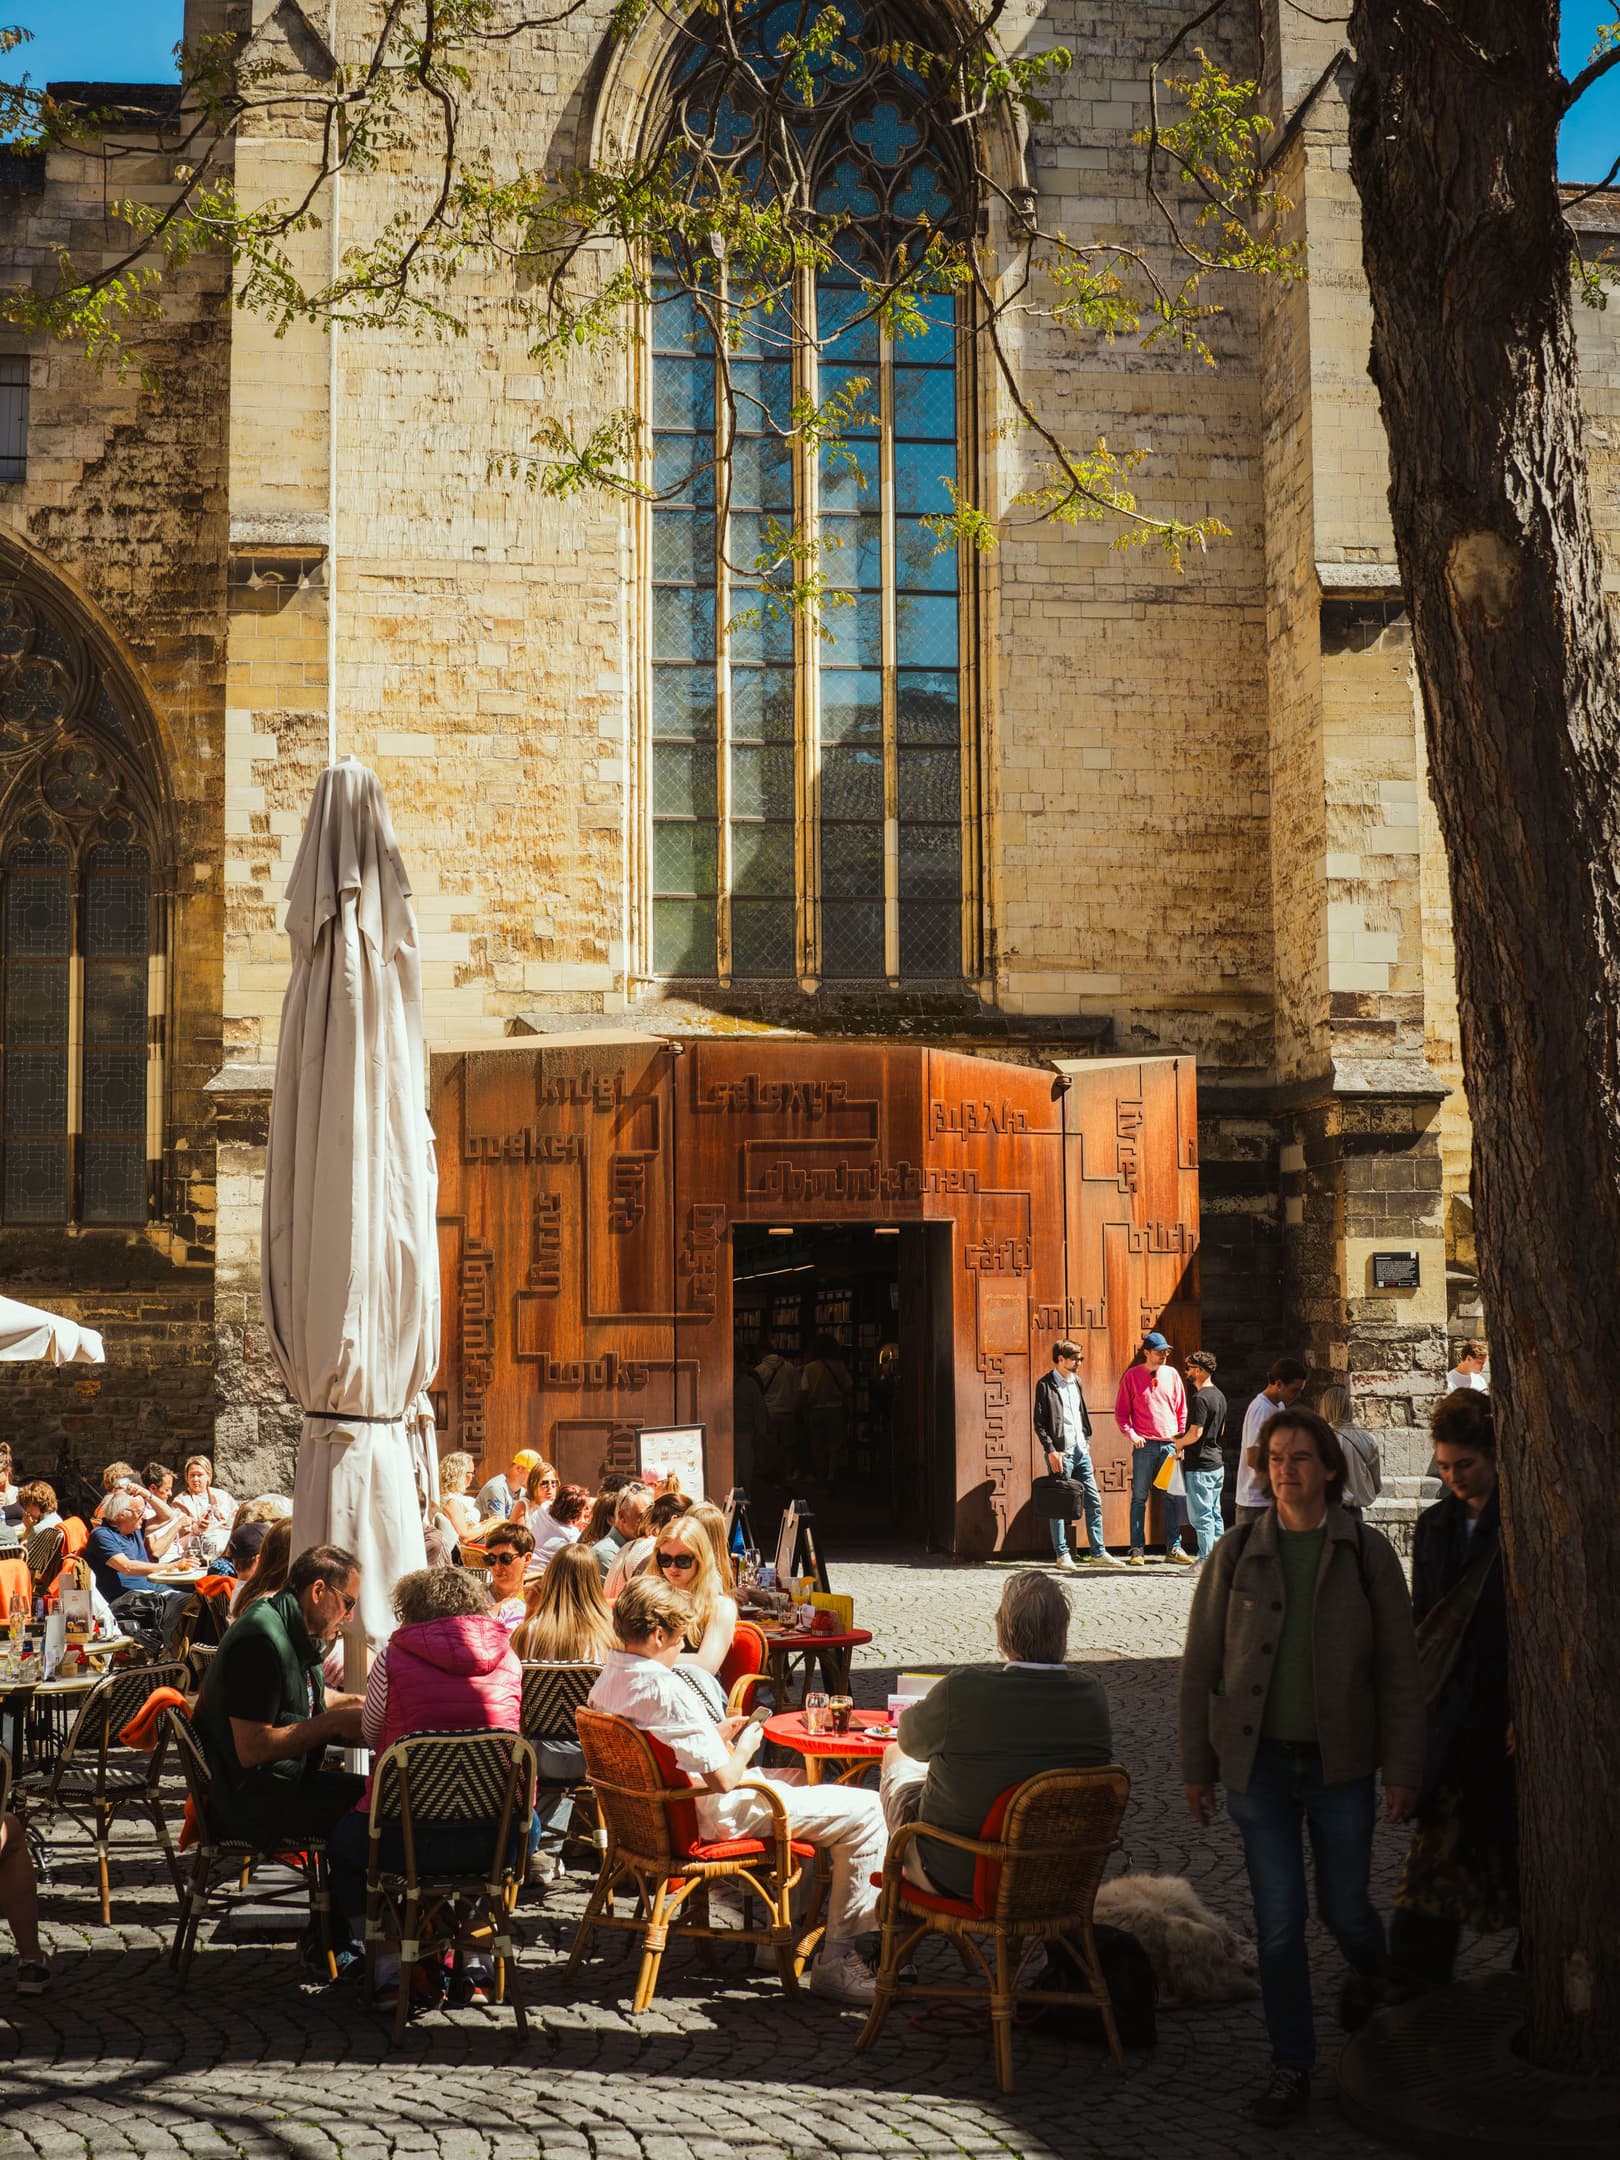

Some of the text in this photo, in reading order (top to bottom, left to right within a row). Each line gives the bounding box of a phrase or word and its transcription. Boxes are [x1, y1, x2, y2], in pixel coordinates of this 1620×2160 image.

[766, 1161, 979, 1193] dominicanen
[1115, 1097, 1144, 1194] livres
[531, 1191, 561, 1290] livros
[547, 1352, 650, 1384] books
